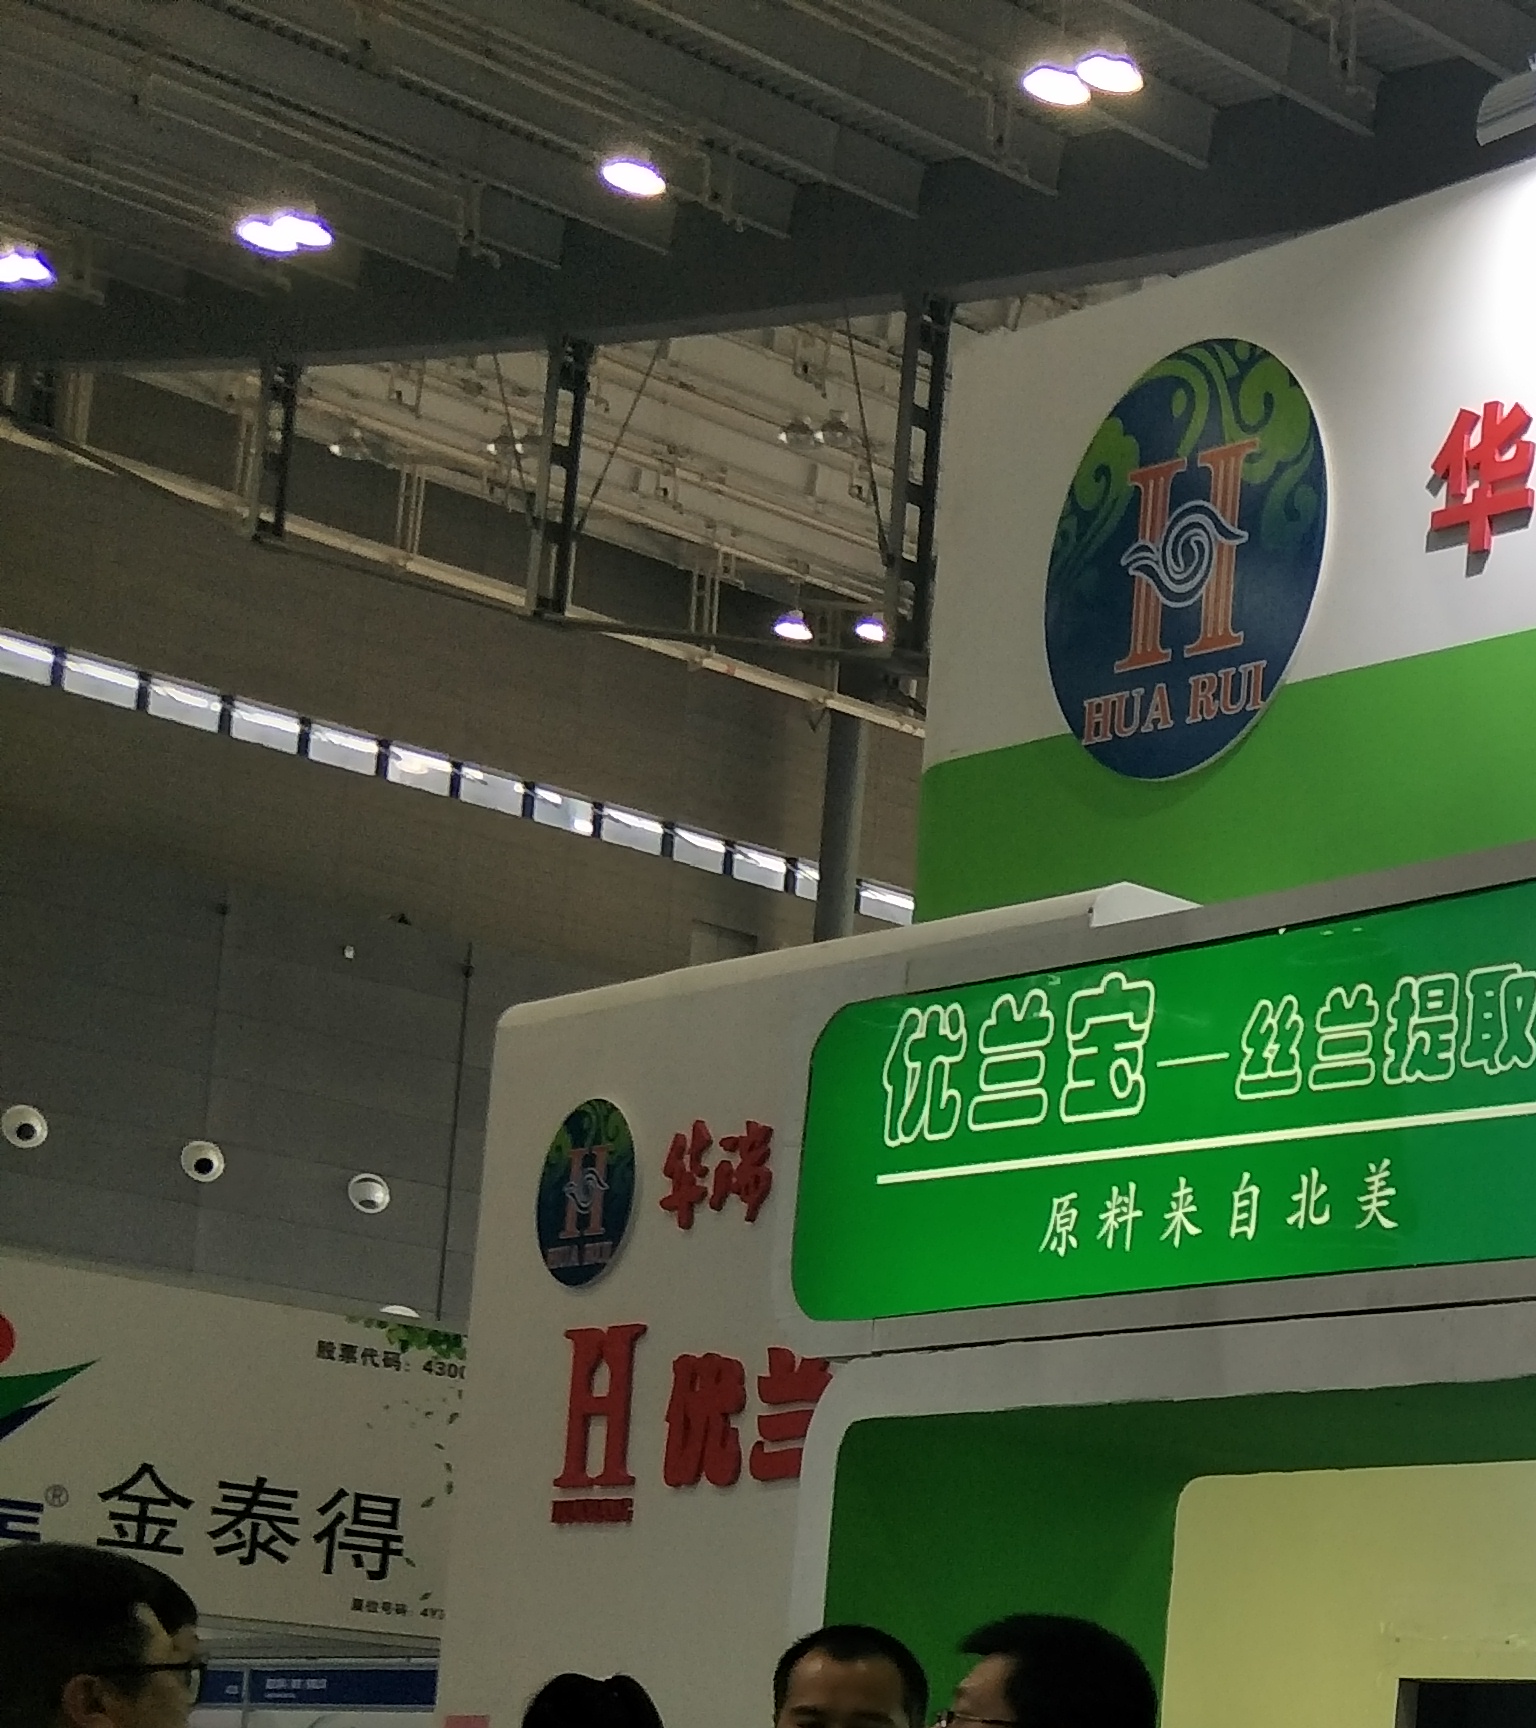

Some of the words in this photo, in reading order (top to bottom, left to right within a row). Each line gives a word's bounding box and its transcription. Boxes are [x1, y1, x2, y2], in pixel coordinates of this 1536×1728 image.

[1081, 683, 1174, 746] HUA
[1186, 659, 1268, 725] RUI
[1039, 1158, 1399, 1258] 原料来自北美
[97, 1462, 404, 1581] 金泰得
